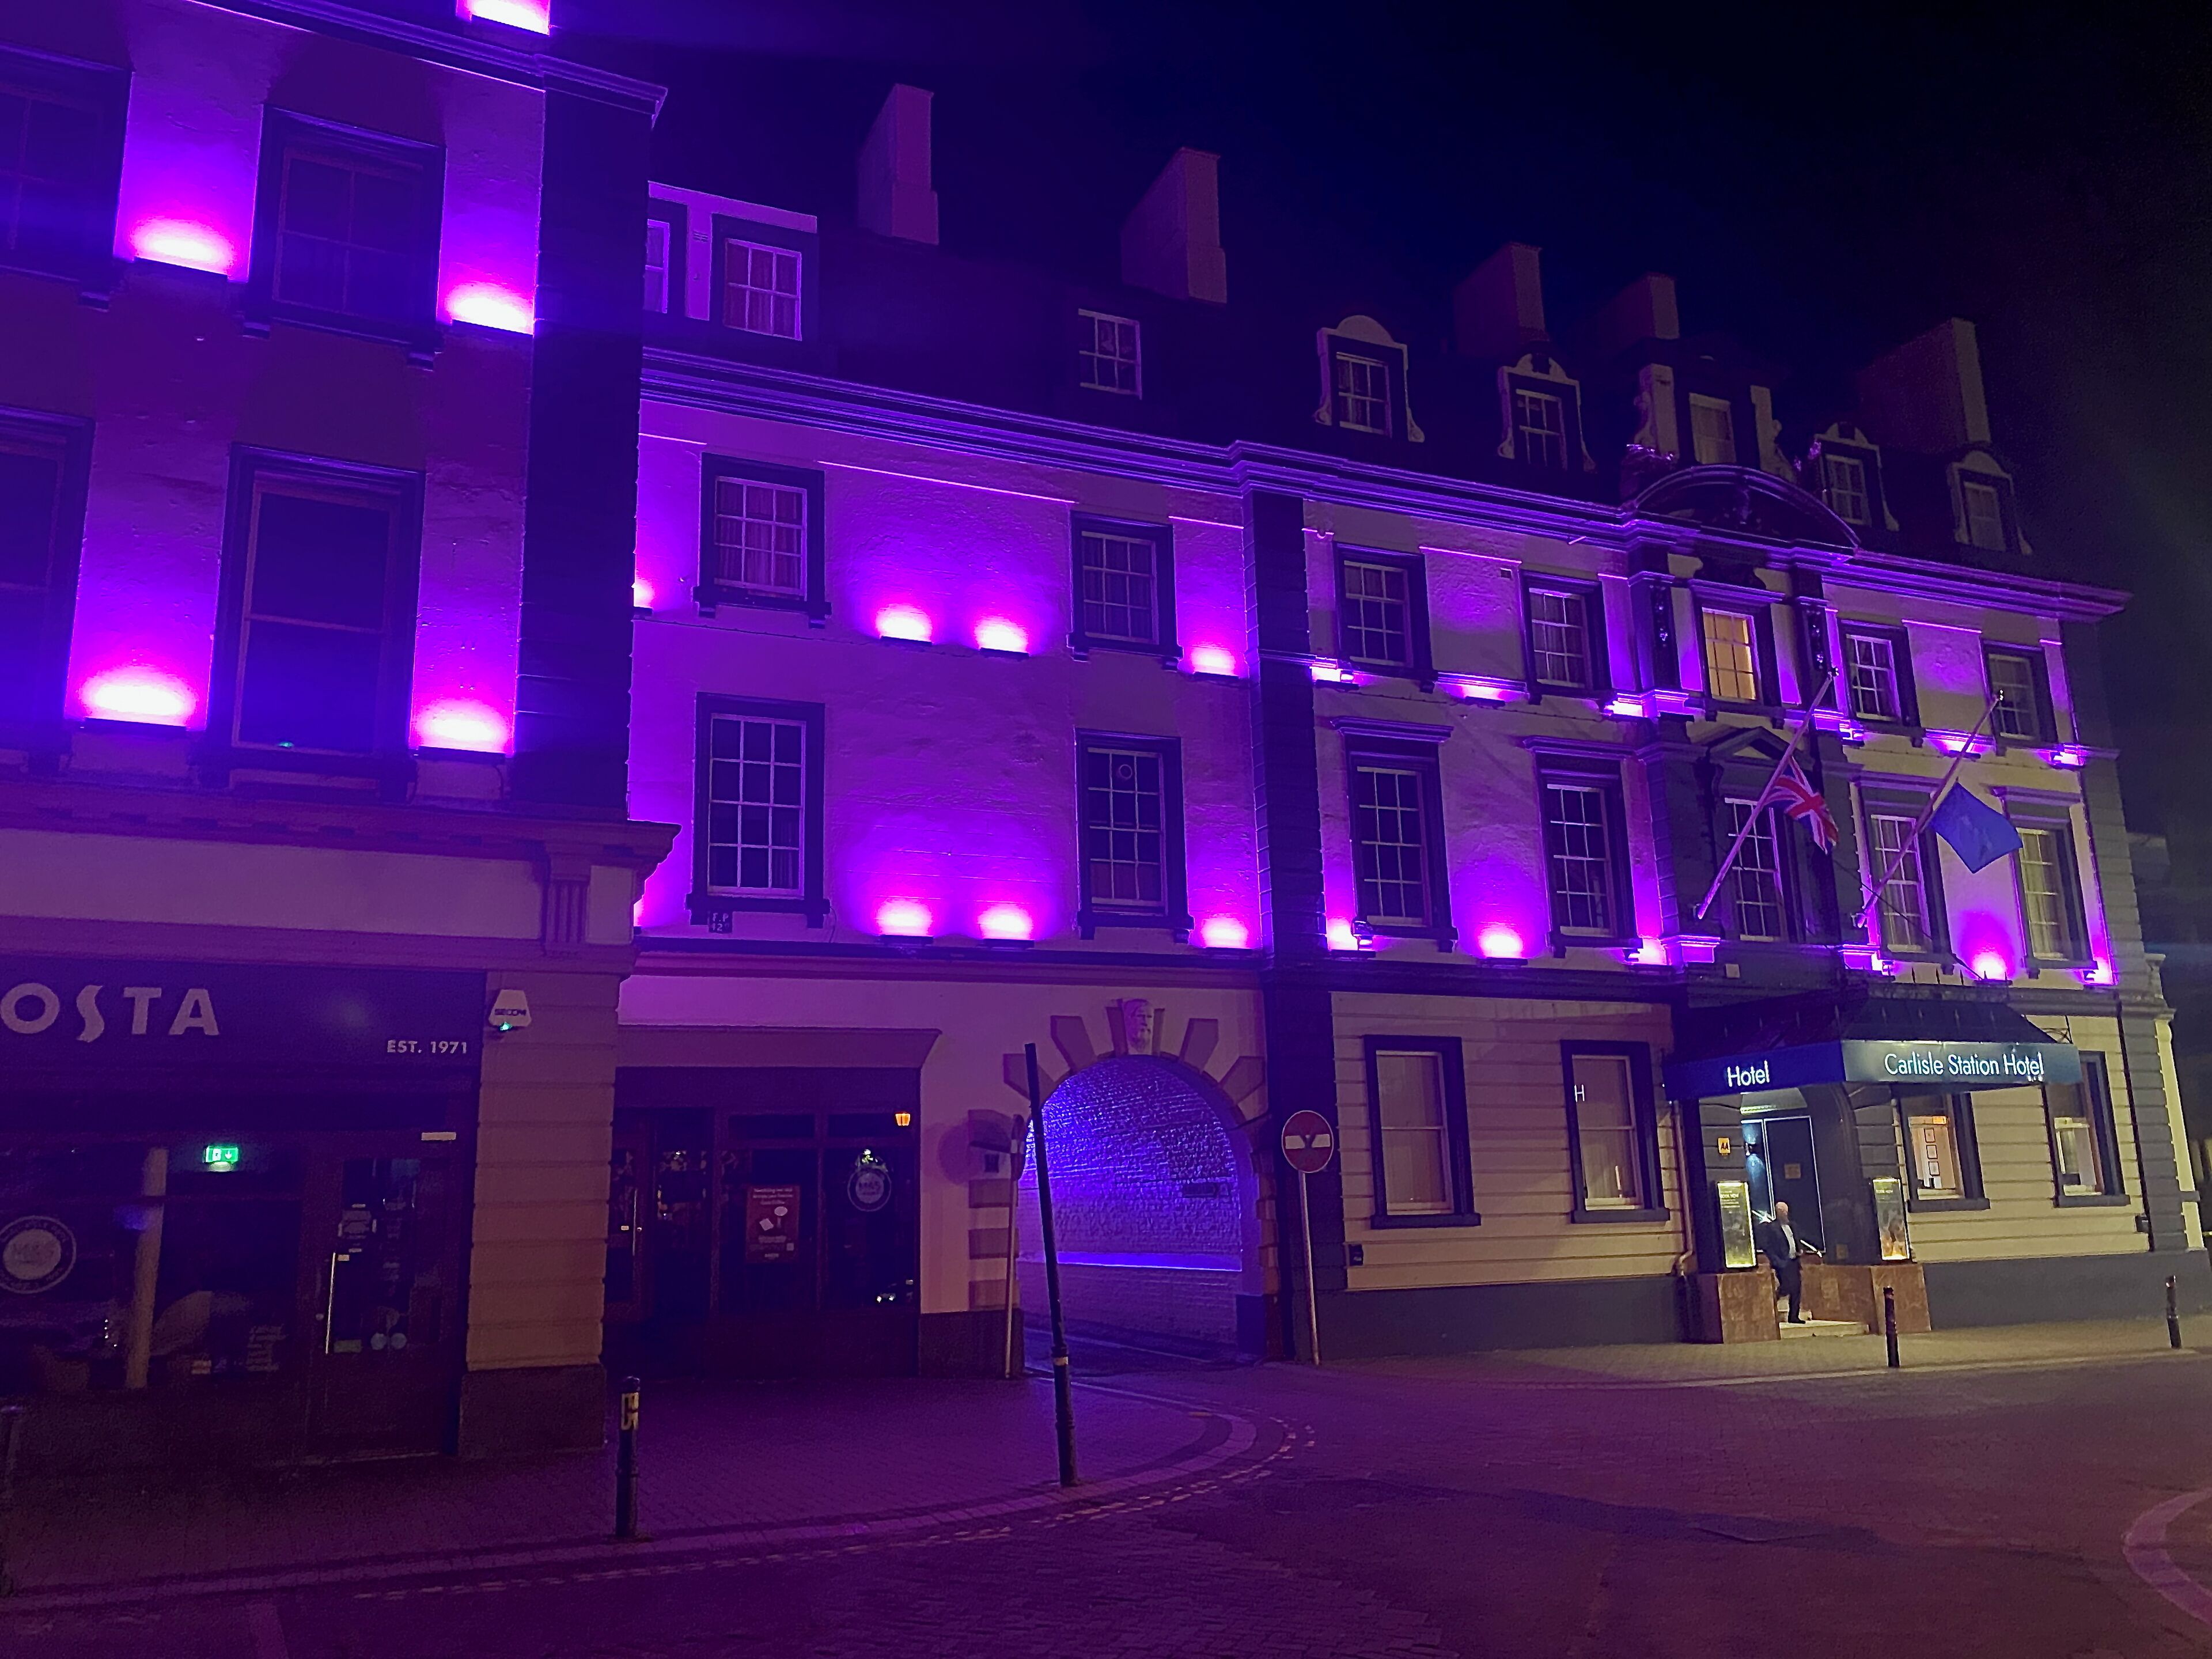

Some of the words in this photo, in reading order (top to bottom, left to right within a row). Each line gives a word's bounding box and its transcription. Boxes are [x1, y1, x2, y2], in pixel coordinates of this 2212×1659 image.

[387, 1039, 422, 1053] EST.
[430, 1040, 467, 1054] 1971
[1727, 1060, 1770, 1088] Hotel
[1884, 1051, 1944, 1075] Carlisle
[1948, 1053, 2000, 1075] Station
[2003, 1051, 2045, 1075] Hotel
